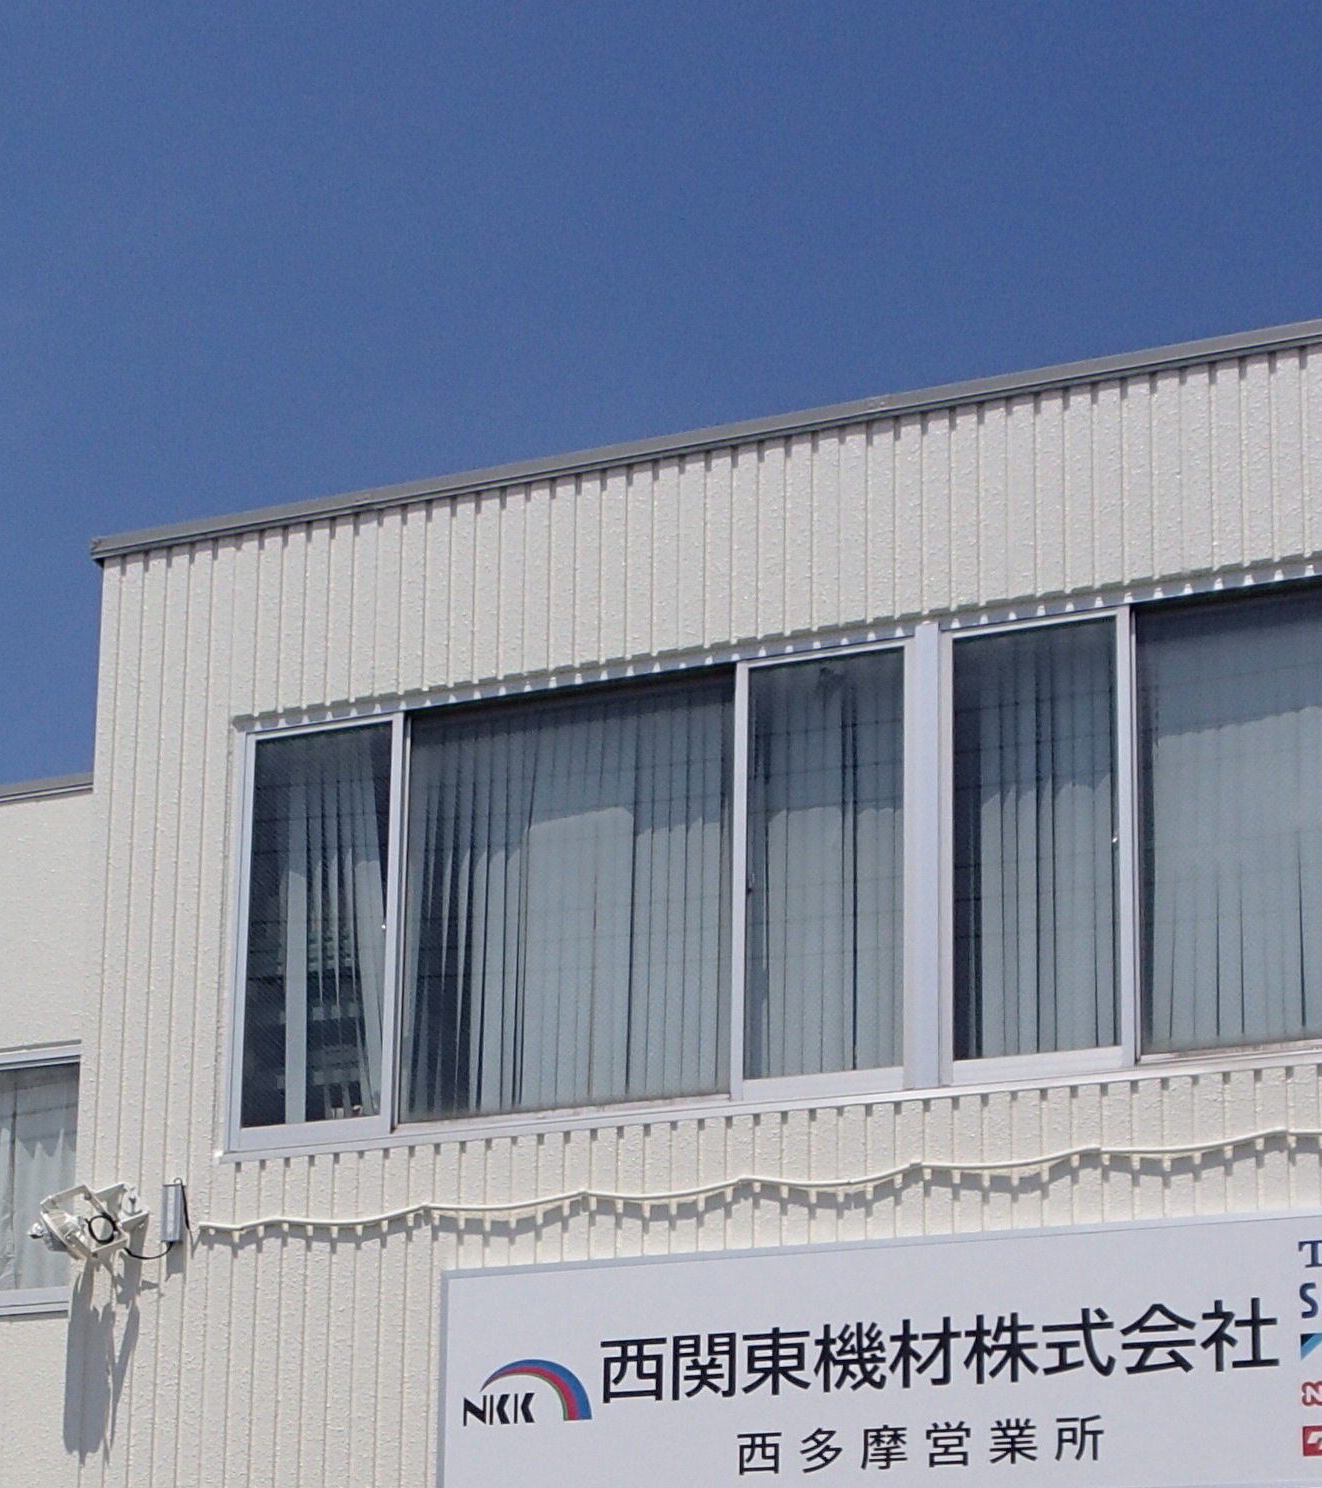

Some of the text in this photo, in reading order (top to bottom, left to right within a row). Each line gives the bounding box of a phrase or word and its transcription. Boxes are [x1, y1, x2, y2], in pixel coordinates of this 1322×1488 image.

[600, 1297, 1280, 1404] 西関東機材株式会社
[463, 1392, 536, 1427] NKK
[736, 1414, 1105, 1476] 西多摩営業所
